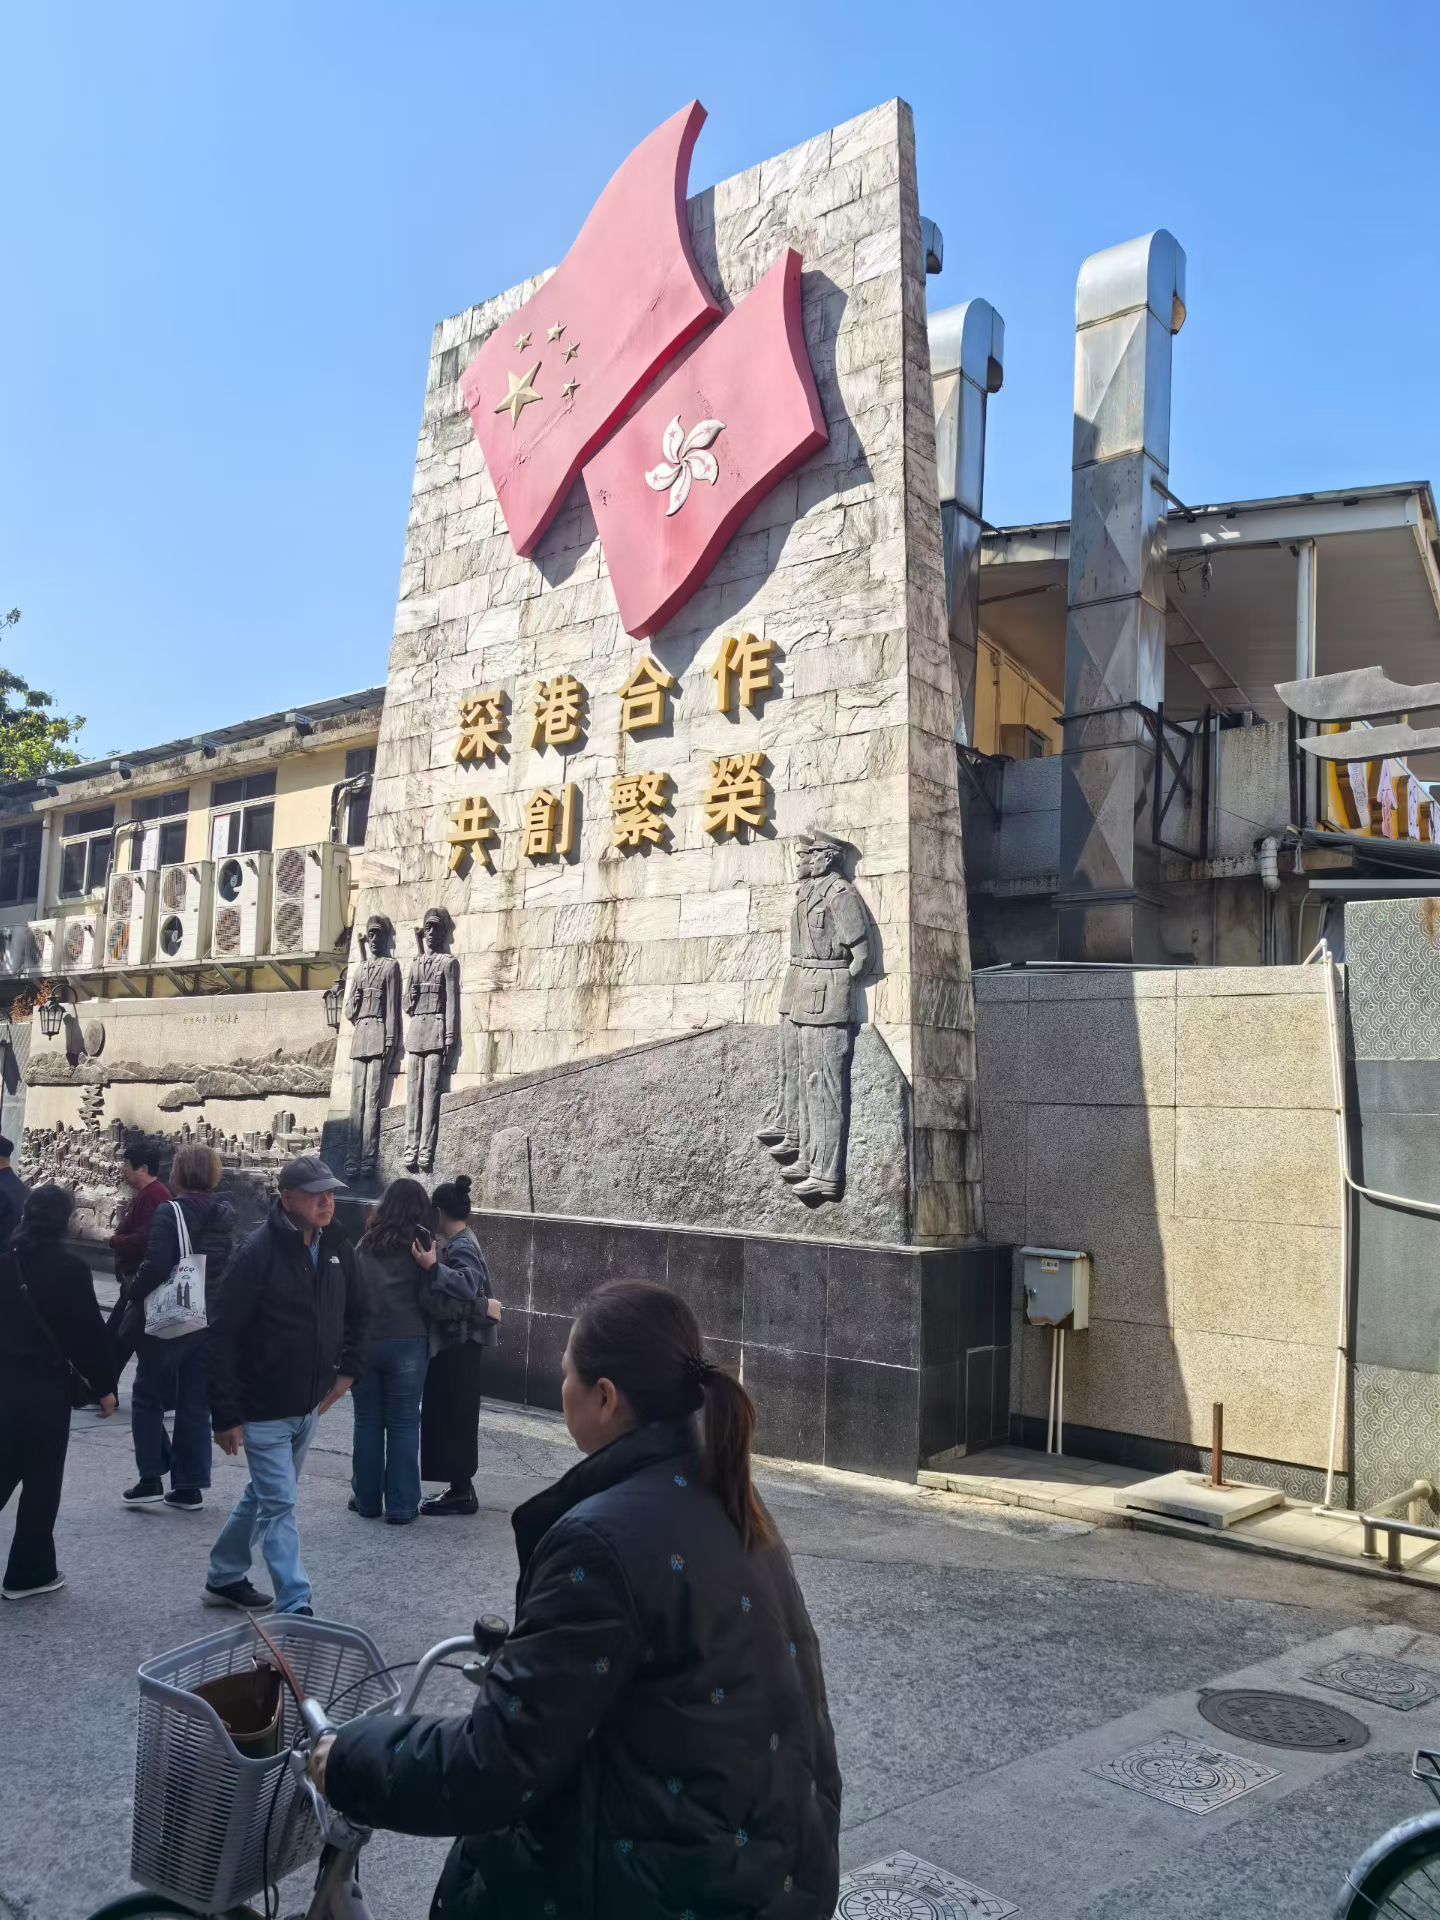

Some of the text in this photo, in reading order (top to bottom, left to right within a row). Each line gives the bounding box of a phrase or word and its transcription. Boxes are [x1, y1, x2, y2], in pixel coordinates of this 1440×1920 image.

[455, 632, 776, 763] 深港合作
[448, 752, 767, 871] 共創繁榮
